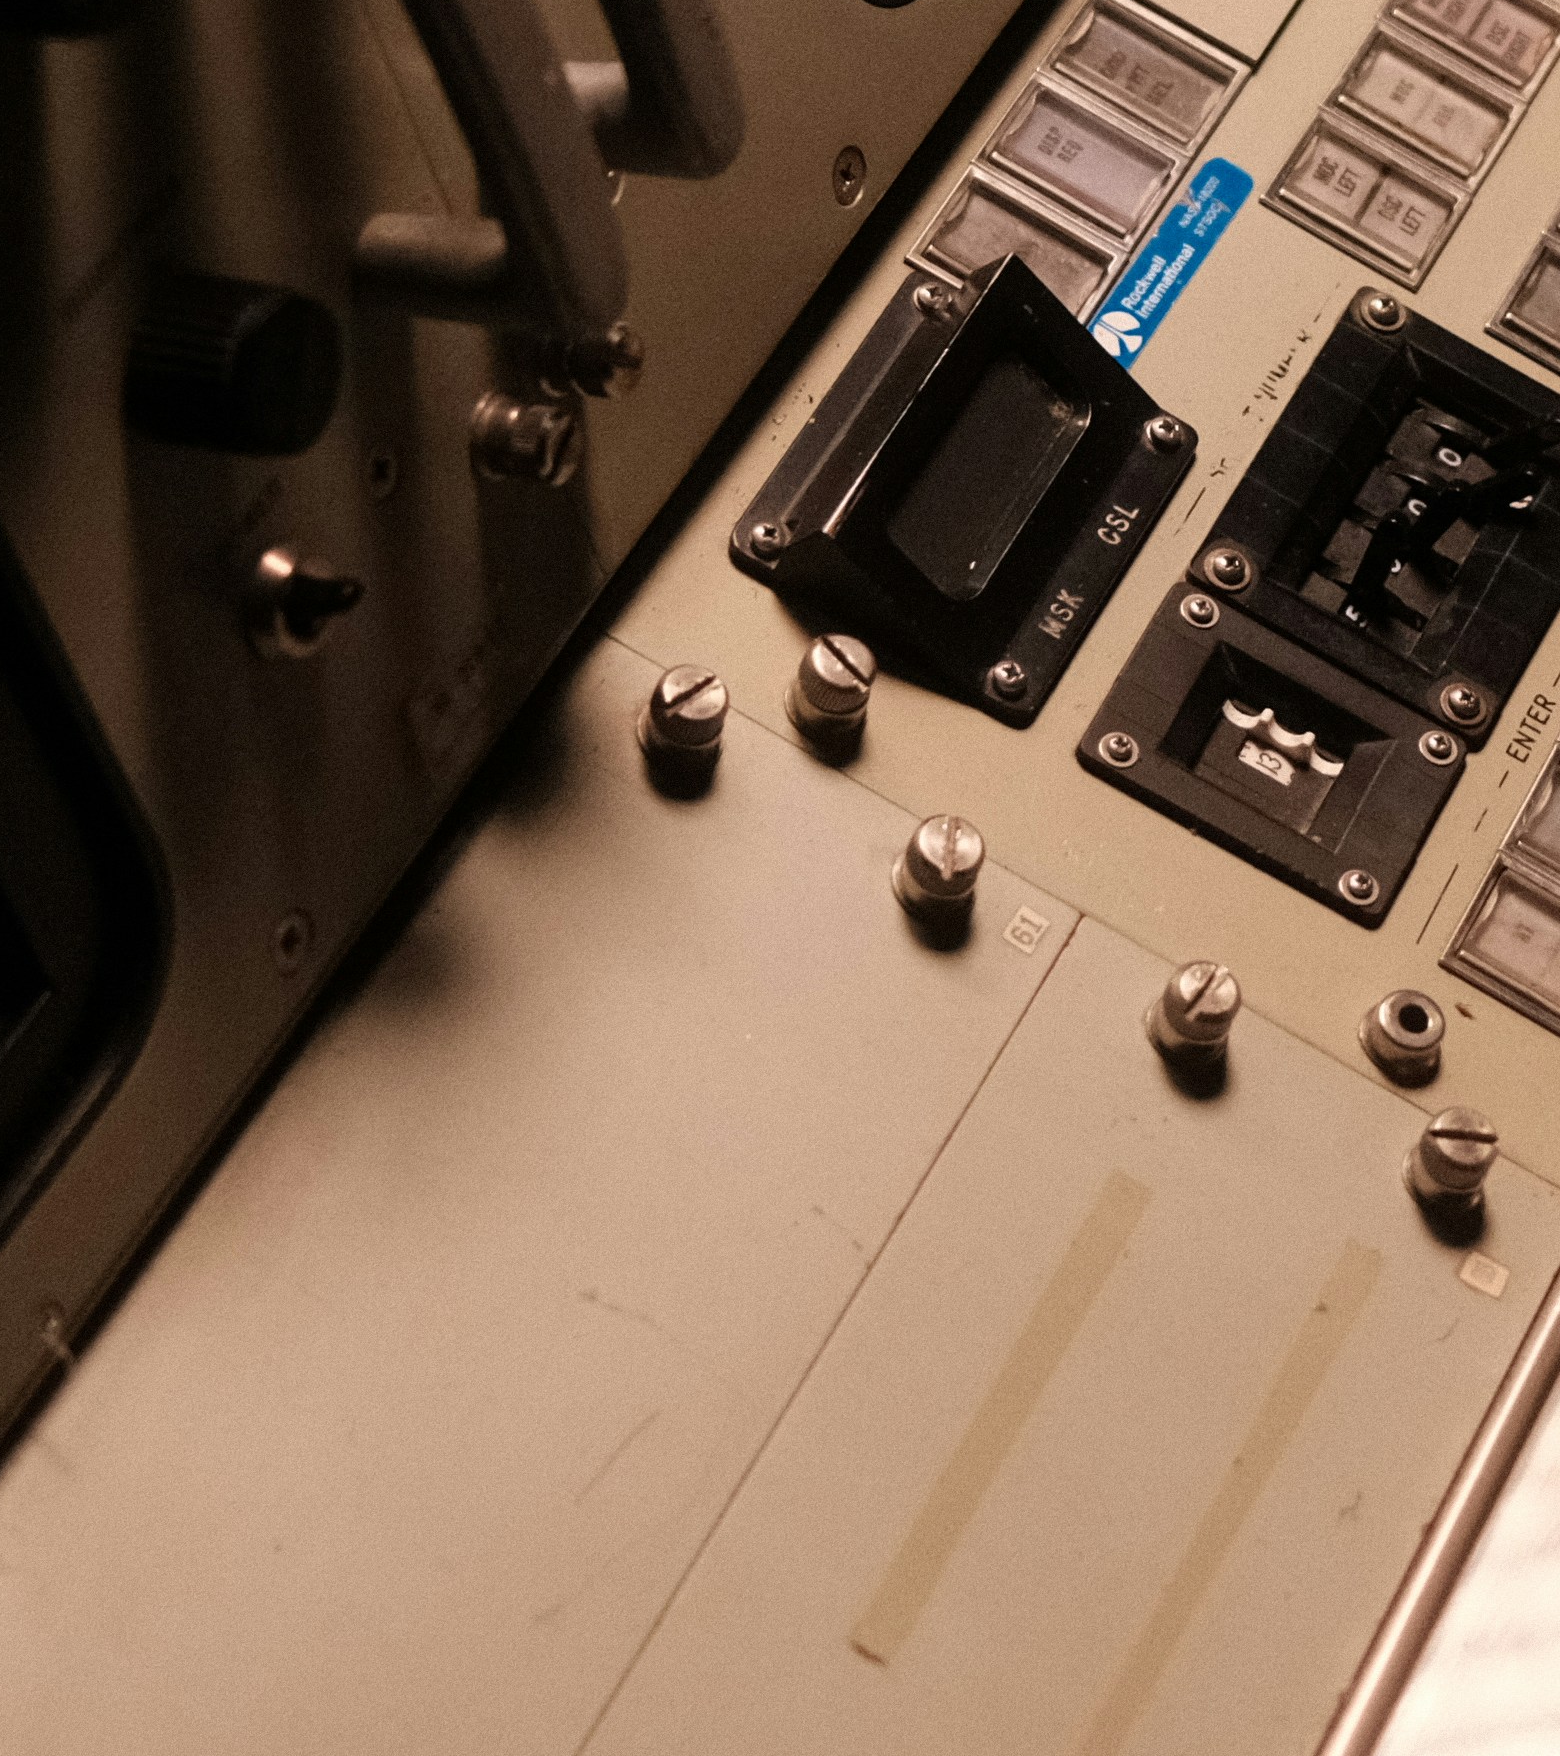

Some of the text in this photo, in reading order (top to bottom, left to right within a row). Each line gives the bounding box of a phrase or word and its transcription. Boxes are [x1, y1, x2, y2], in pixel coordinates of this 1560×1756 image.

[1334, 167, 1362, 198] LEFT
[1398, 205, 1426, 236] LEFT
[1121, 253, 1165, 311] Rockwell
[1135, 240, 1194, 320] International
[1039, 497, 1141, 639] MSK CSL
[1506, 692, 1558, 764] ENTER
[1009, 914, 1041, 947] 61
